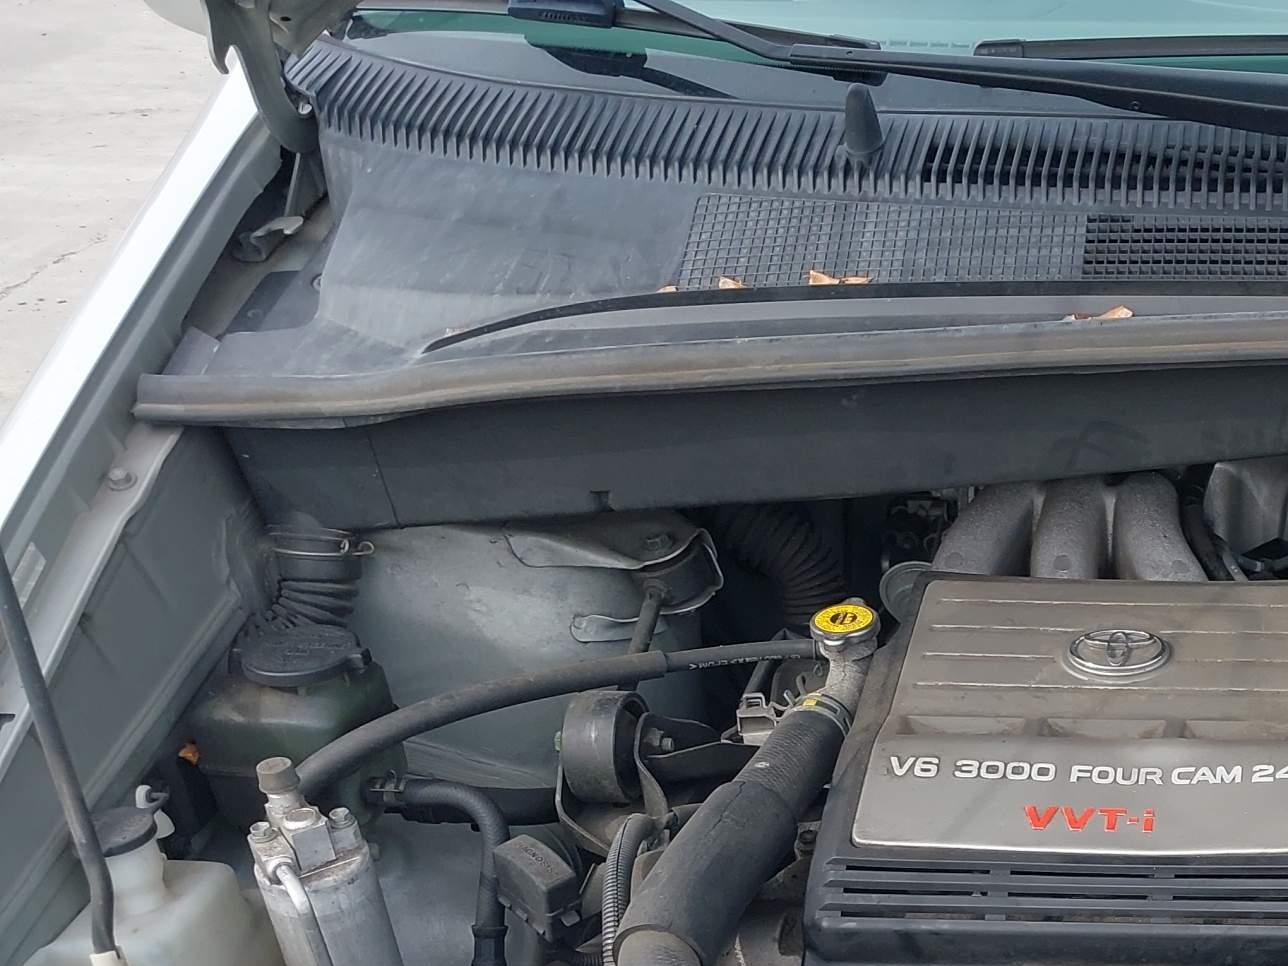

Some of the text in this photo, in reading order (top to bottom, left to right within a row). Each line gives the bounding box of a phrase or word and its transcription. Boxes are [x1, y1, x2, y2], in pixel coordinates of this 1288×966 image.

[889, 756, 939, 778] V6
[953, 760, 1056, 782] 3000
[1069, 765, 1164, 785] FOUR
[1171, 765, 1243, 785] CAM
[1023, 805, 1157, 833] VVT-i
